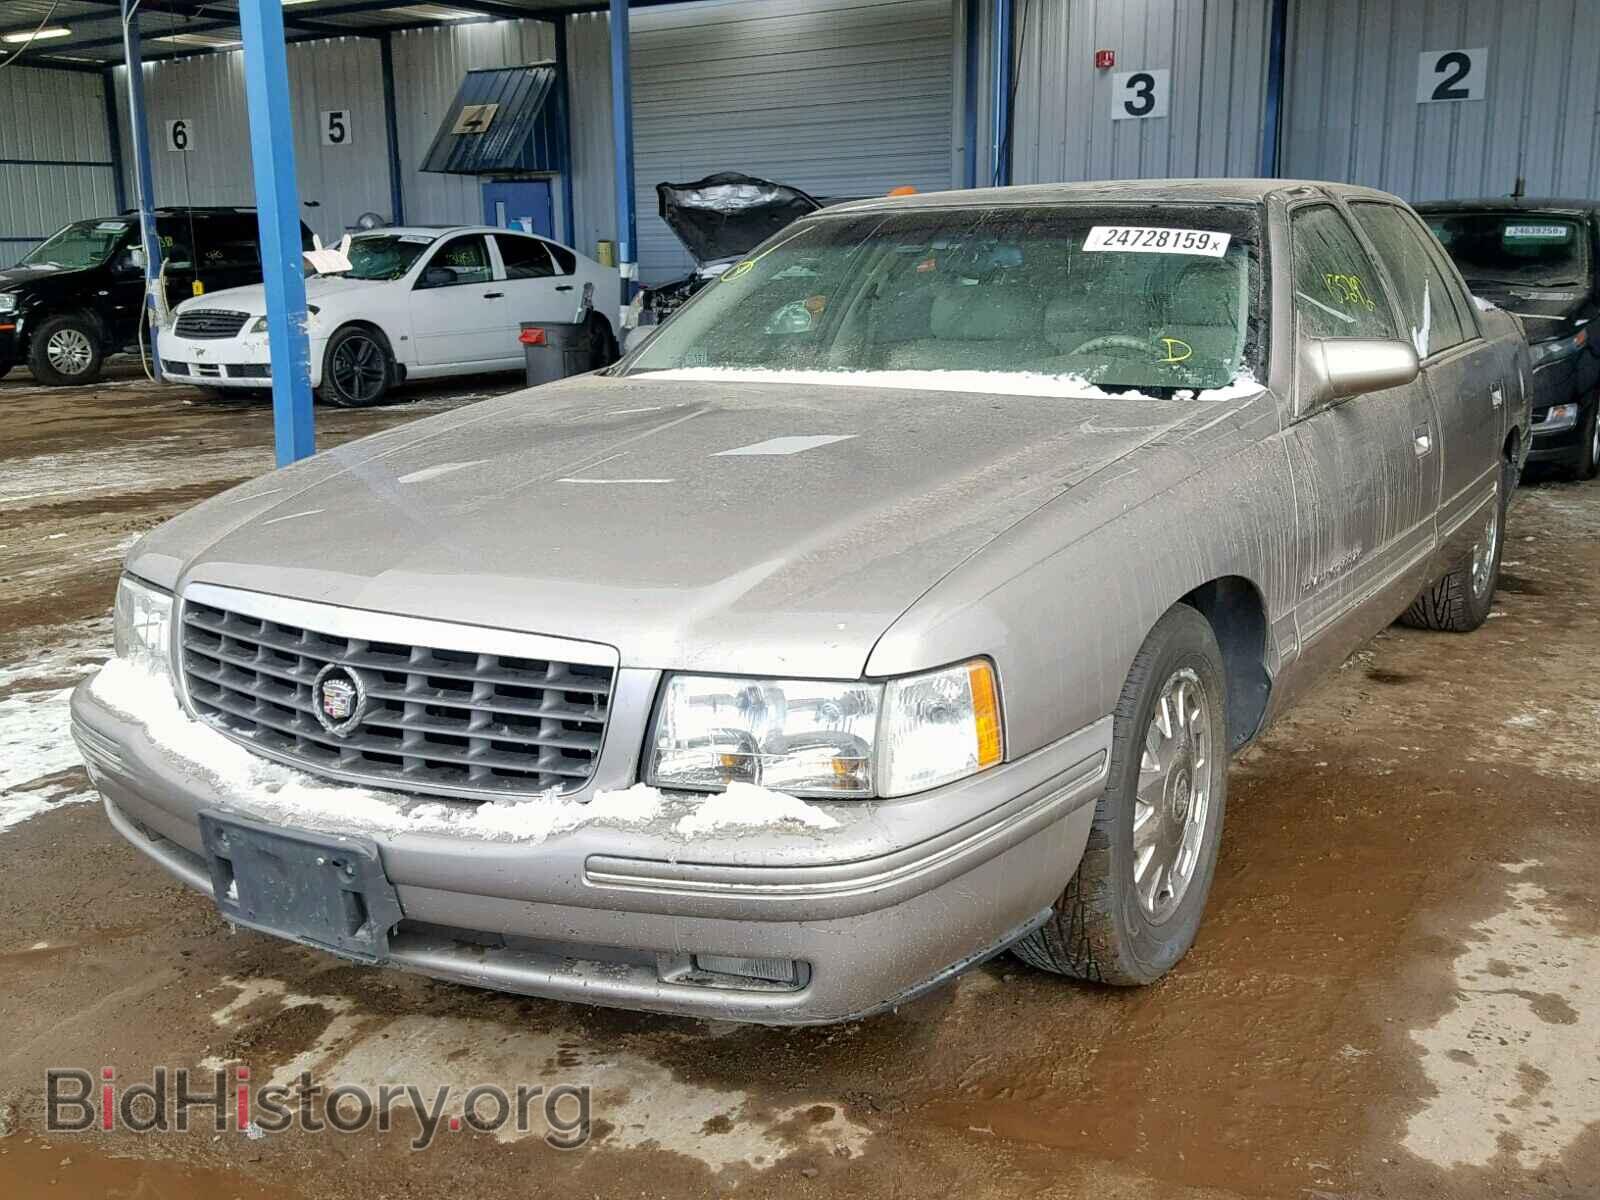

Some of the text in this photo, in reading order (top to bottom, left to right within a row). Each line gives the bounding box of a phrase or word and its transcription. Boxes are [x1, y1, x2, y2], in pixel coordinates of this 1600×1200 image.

[1431, 52, 1471, 100] 2
[1124, 73, 1155, 116] 3
[328, 112, 344, 143] 5
[462, 105, 488, 131] 4
[172, 121, 187, 149] 6
[1158, 338, 1192, 362] D
